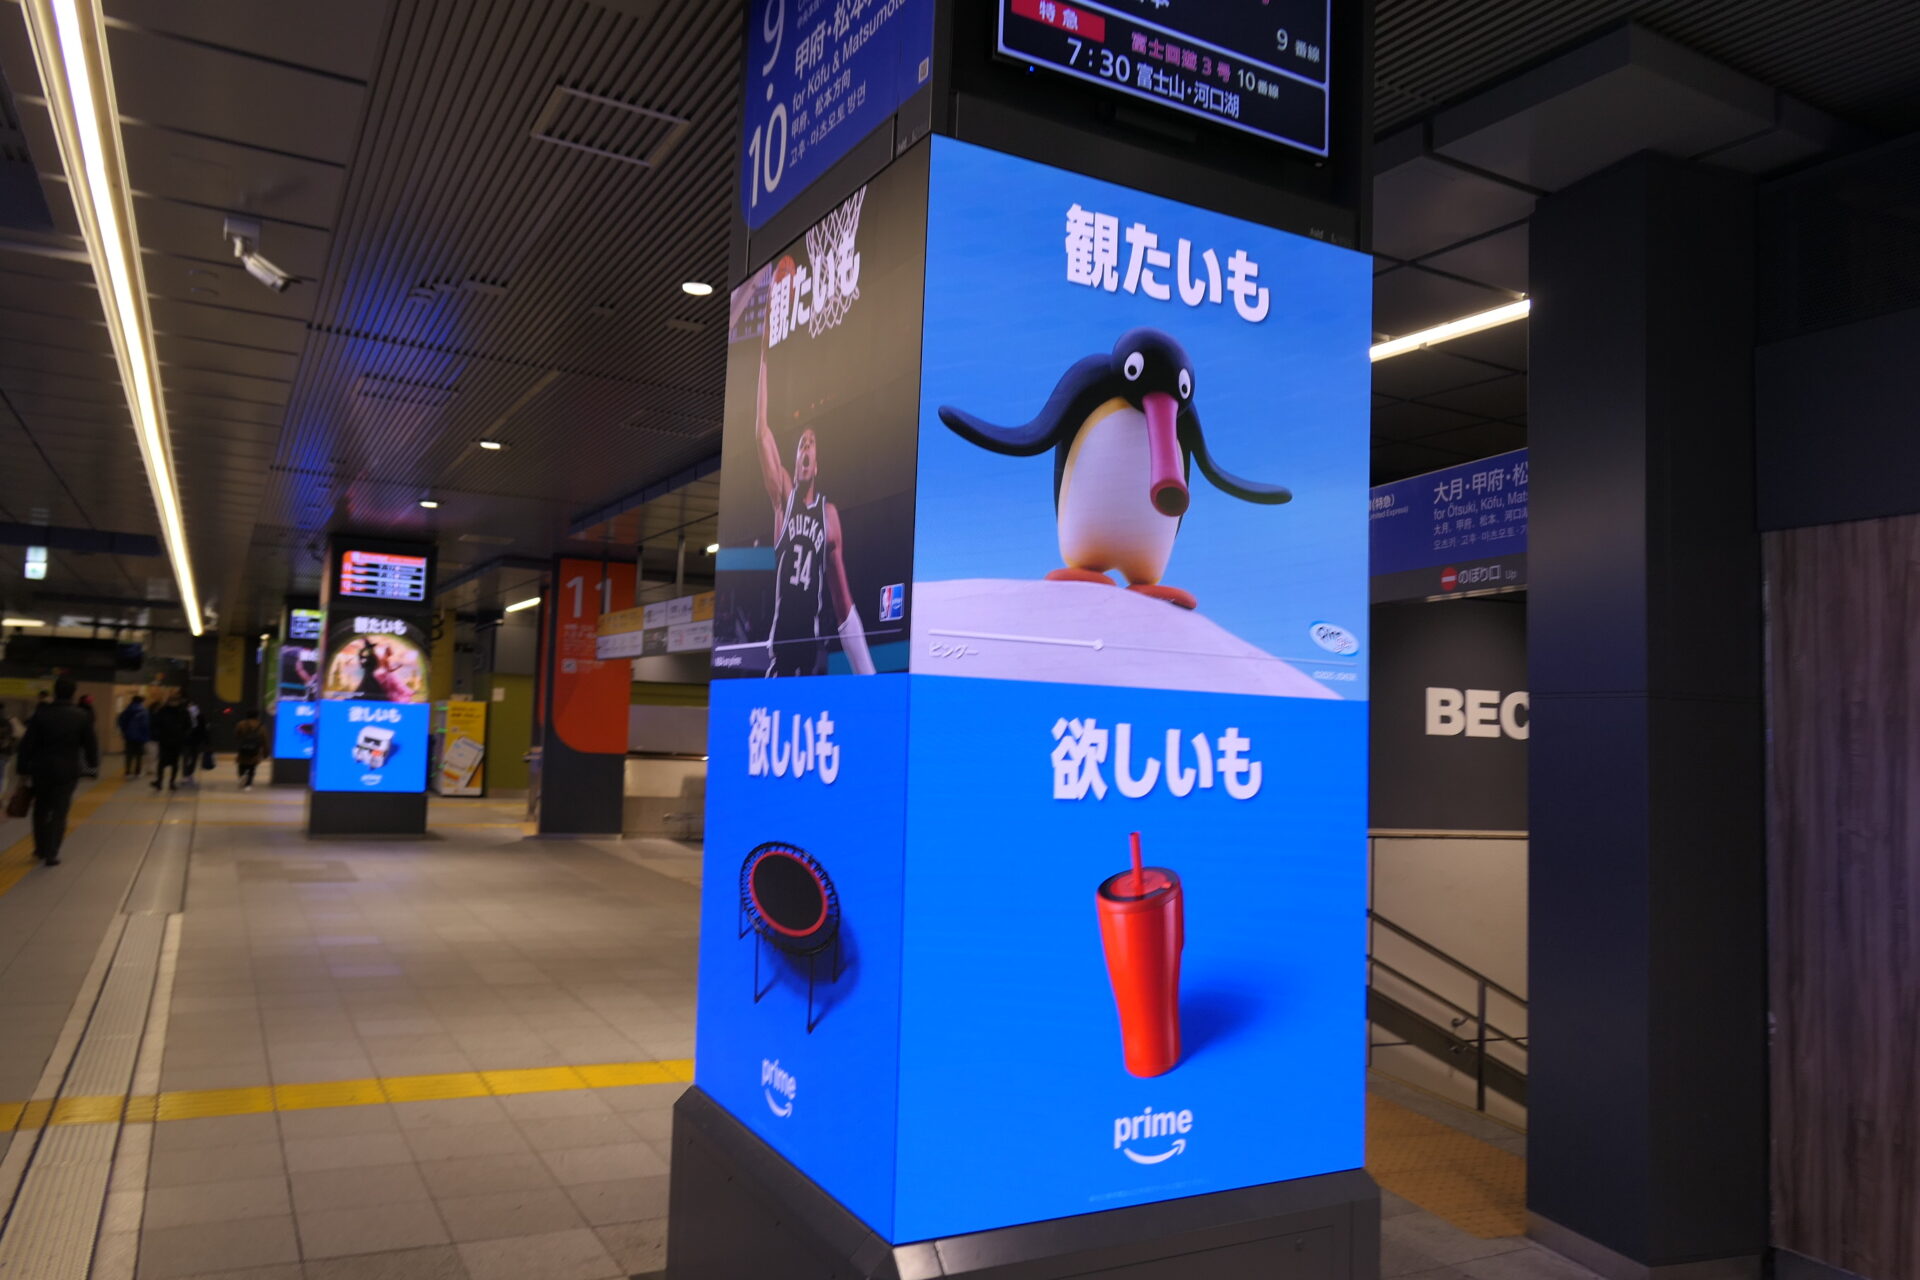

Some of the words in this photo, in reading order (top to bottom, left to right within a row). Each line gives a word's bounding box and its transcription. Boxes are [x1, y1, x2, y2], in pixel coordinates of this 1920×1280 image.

[762, 0, 785, 76] 9
[792, 87, 806, 114] for
[807, 63, 830, 99] Kōfu
[832, 51, 840, 73] &
[1066, 37, 1131, 82] 7:30
[1136, 62, 1240, 119] 富士山・河口湖
[749, 103, 787, 208] 10
[769, 230, 861, 348] 観たいも
[1065, 203, 1271, 323] 観たいも
[788, 514, 825, 554] BUCKS
[1434, 508, 1446, 520] for
[1508, 490, 1528, 505] Mat
[790, 544, 813, 591] 34
[1458, 564, 1501, 584] のぼり口
[748, 706, 840, 785] 欲しいも
[1051, 716, 1262, 801] 欲しいも
[761, 1057, 797, 1101] prime
[1114, 1106, 1194, 1150] prime
